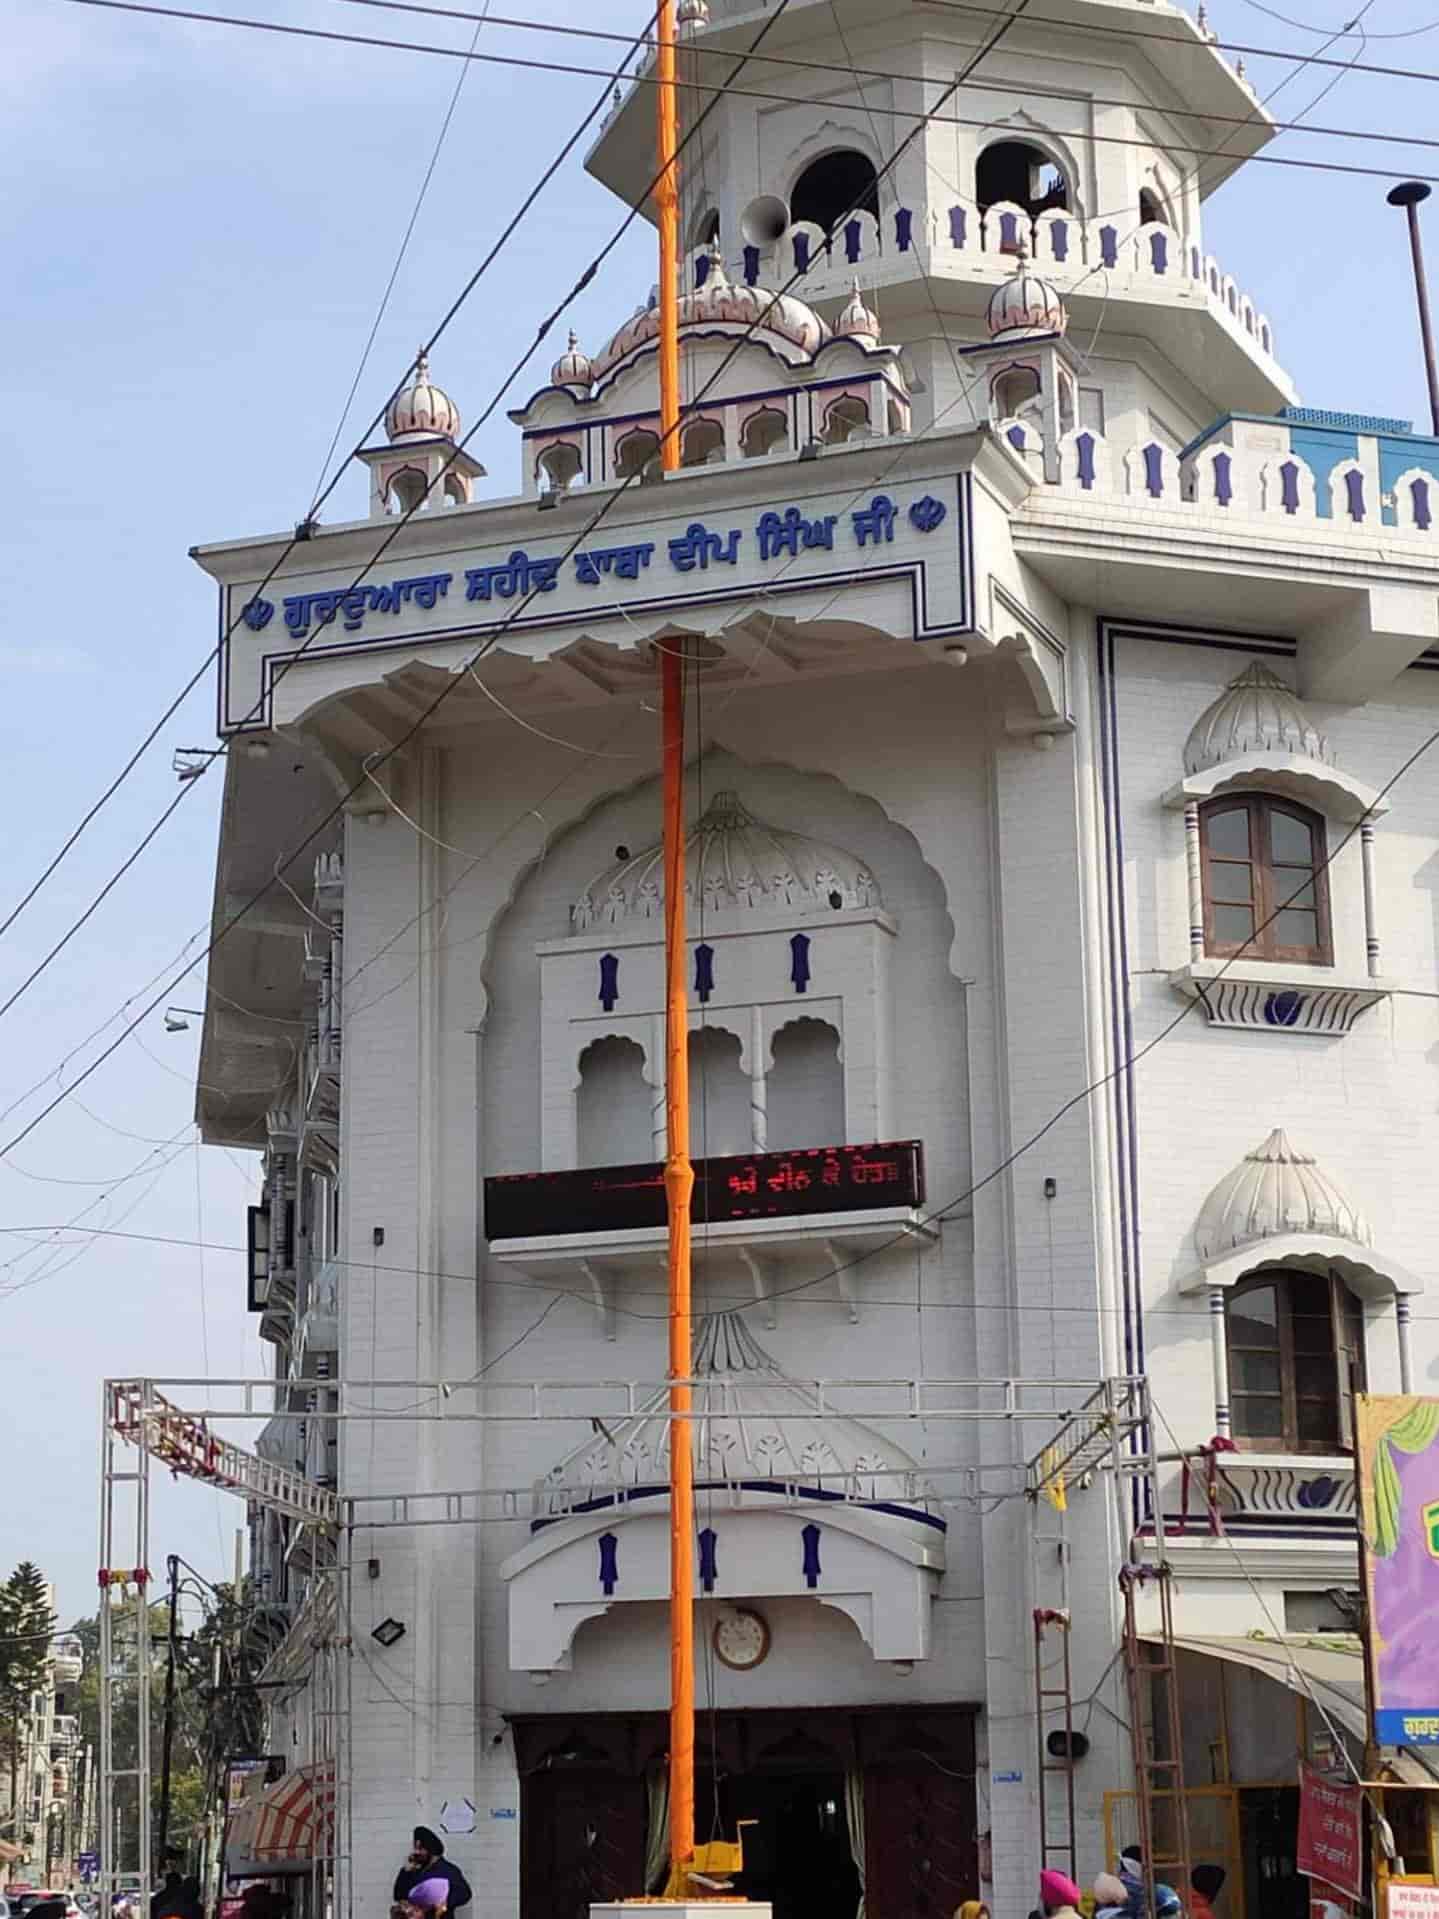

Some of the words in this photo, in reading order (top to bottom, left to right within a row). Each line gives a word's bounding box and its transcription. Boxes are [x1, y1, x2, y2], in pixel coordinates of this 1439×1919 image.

[283, 573, 452, 637] ਗੁਰਦੁਆਰਾ
[574, 543, 655, 585] ਬਾਬਾ
[668, 522, 742, 571] ਦੀਪ
[756, 507, 838, 561] ਸਿੰਘ
[852, 495, 898, 546] ਜੀ
